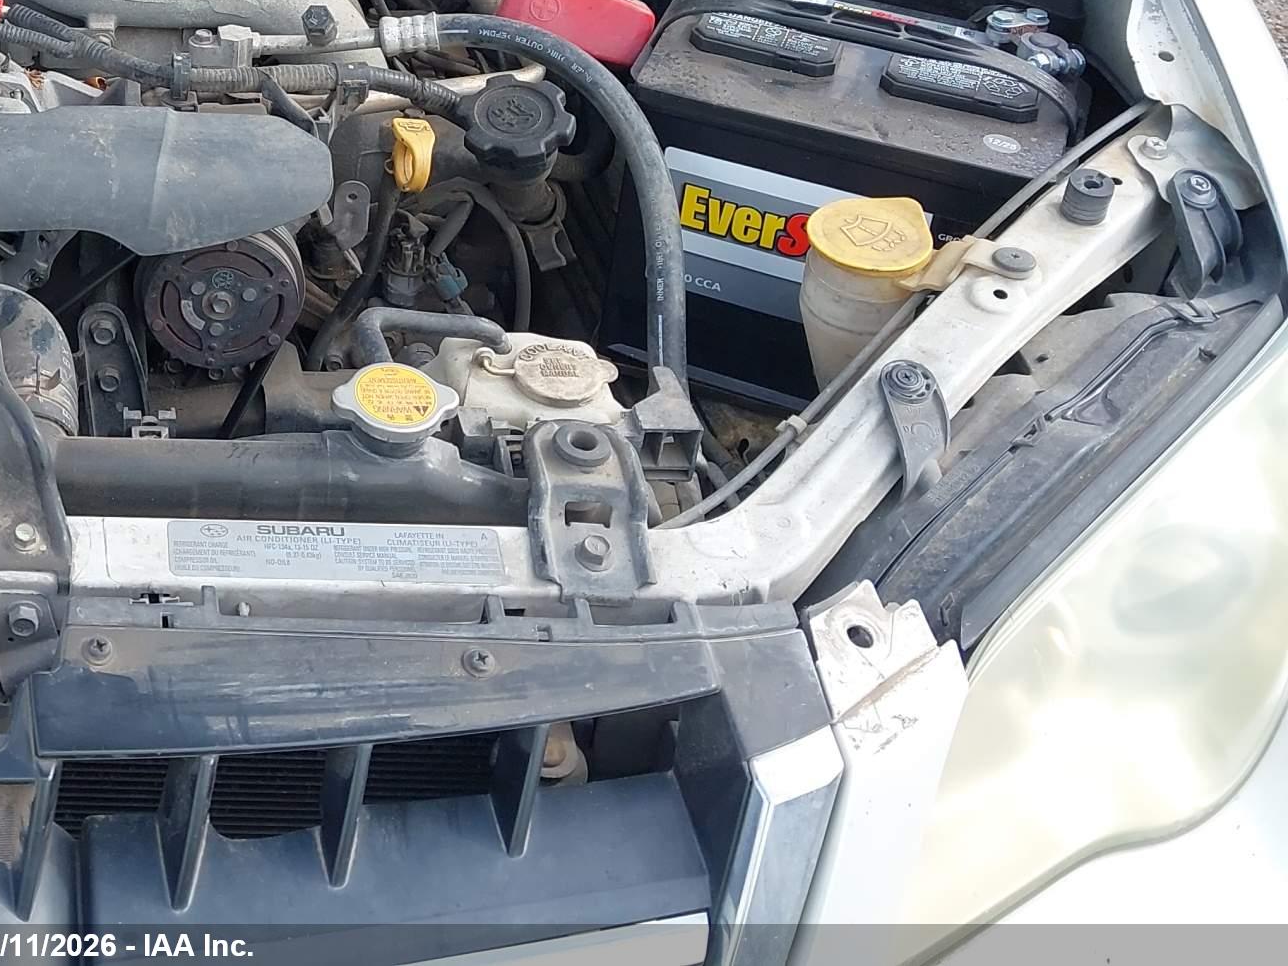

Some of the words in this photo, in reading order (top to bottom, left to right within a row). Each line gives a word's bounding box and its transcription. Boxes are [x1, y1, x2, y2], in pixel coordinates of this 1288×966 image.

[695, 277, 722, 292] CCA
[257, 525, 345, 537] SUBARU
[255, 536, 318, 544] CONDITIONER
[480, 532, 488, 541] A
